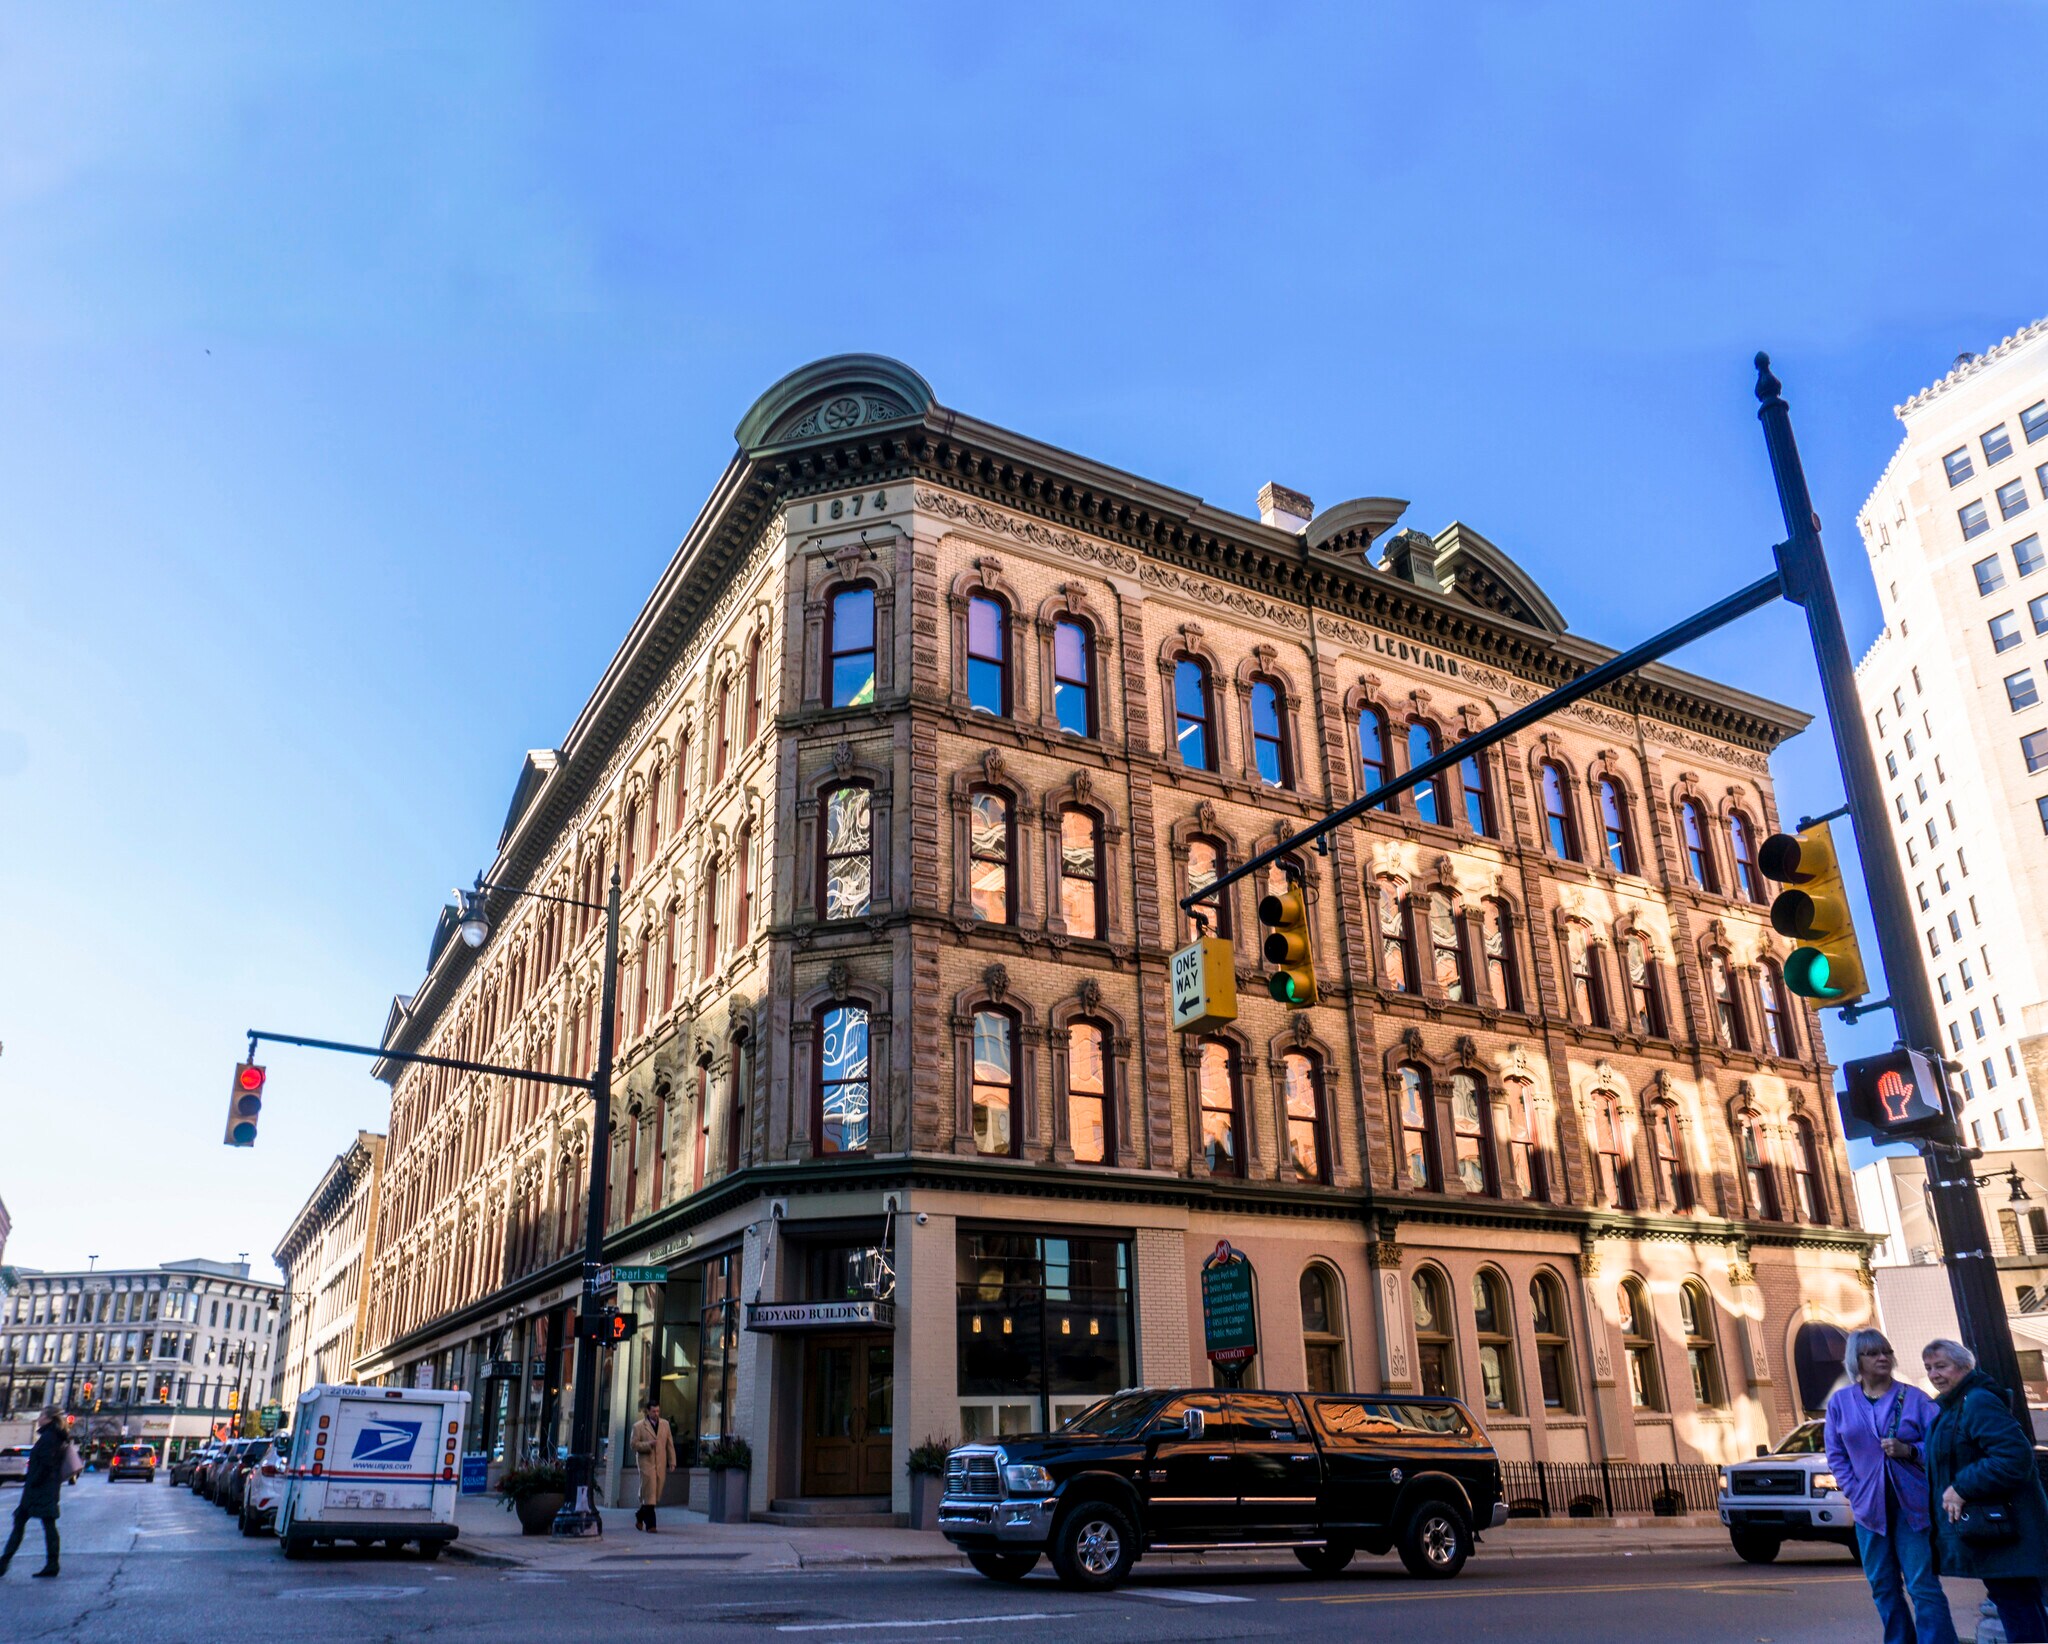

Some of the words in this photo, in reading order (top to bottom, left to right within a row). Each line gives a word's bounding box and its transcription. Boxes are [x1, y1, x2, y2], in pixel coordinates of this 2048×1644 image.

[812, 490, 887, 524] 1874
[1374, 634, 1458, 676] LEDYARD
[1176, 950, 1196, 975] ONE
[1176, 969, 1198, 995] WAY
[615, 1268, 640, 1280] Pearl
[645, 1271, 652, 1279] St
[1230, 1268, 1238, 1278] Hall
[1222, 1282, 1232, 1291] Place
[1223, 1293, 1231, 1302] Ford
[1232, 1291, 1249, 1300] Museum
[750, 1309, 805, 1321] LEDYARD
[808, 1306, 869, 1319] BUILDING
[1211, 1304, 1235, 1315] Government
[1235, 1302, 1249, 1311] Center
[1229, 1315, 1246, 1325] Campus
[1213, 1328, 1225, 1338] Public
[1226, 1327, 1243, 1336] Museum
[330, 1388, 367, 1396] 2210745
[353, 1462, 412, 1471] www.usps.com
